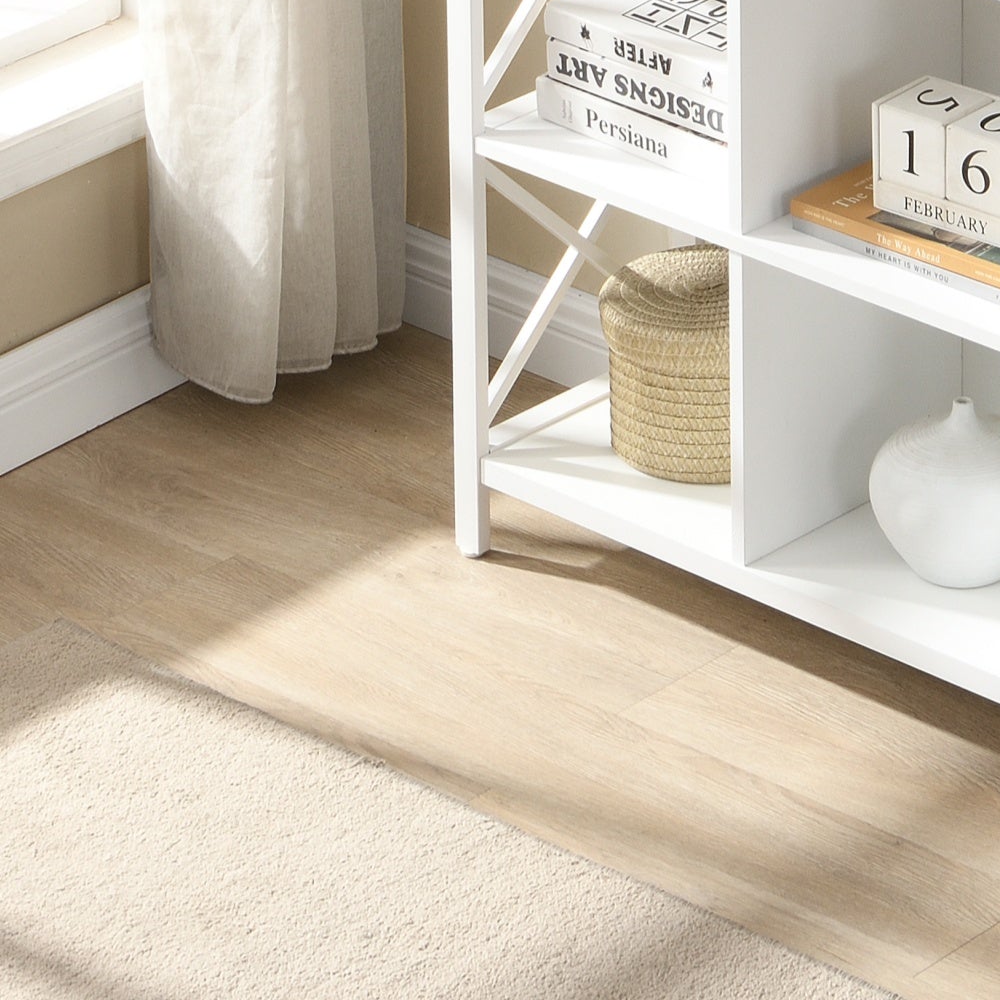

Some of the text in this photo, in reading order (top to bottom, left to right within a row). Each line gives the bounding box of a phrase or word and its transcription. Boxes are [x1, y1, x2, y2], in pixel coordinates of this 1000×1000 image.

[556, 52, 608, 88] ART
[613, 37, 673, 76] AFTER
[614, 72, 725, 133] DESIGNS
[585, 107, 669, 159] Persiana
[901, 130, 991, 195] 1 6
[832, 192, 868, 208] The
[904, 196, 988, 236] FEBRUARY
[865, 246, 949, 284] MY HEART IS WITH YOU
[876, 232, 941, 264] The Way Ahead
